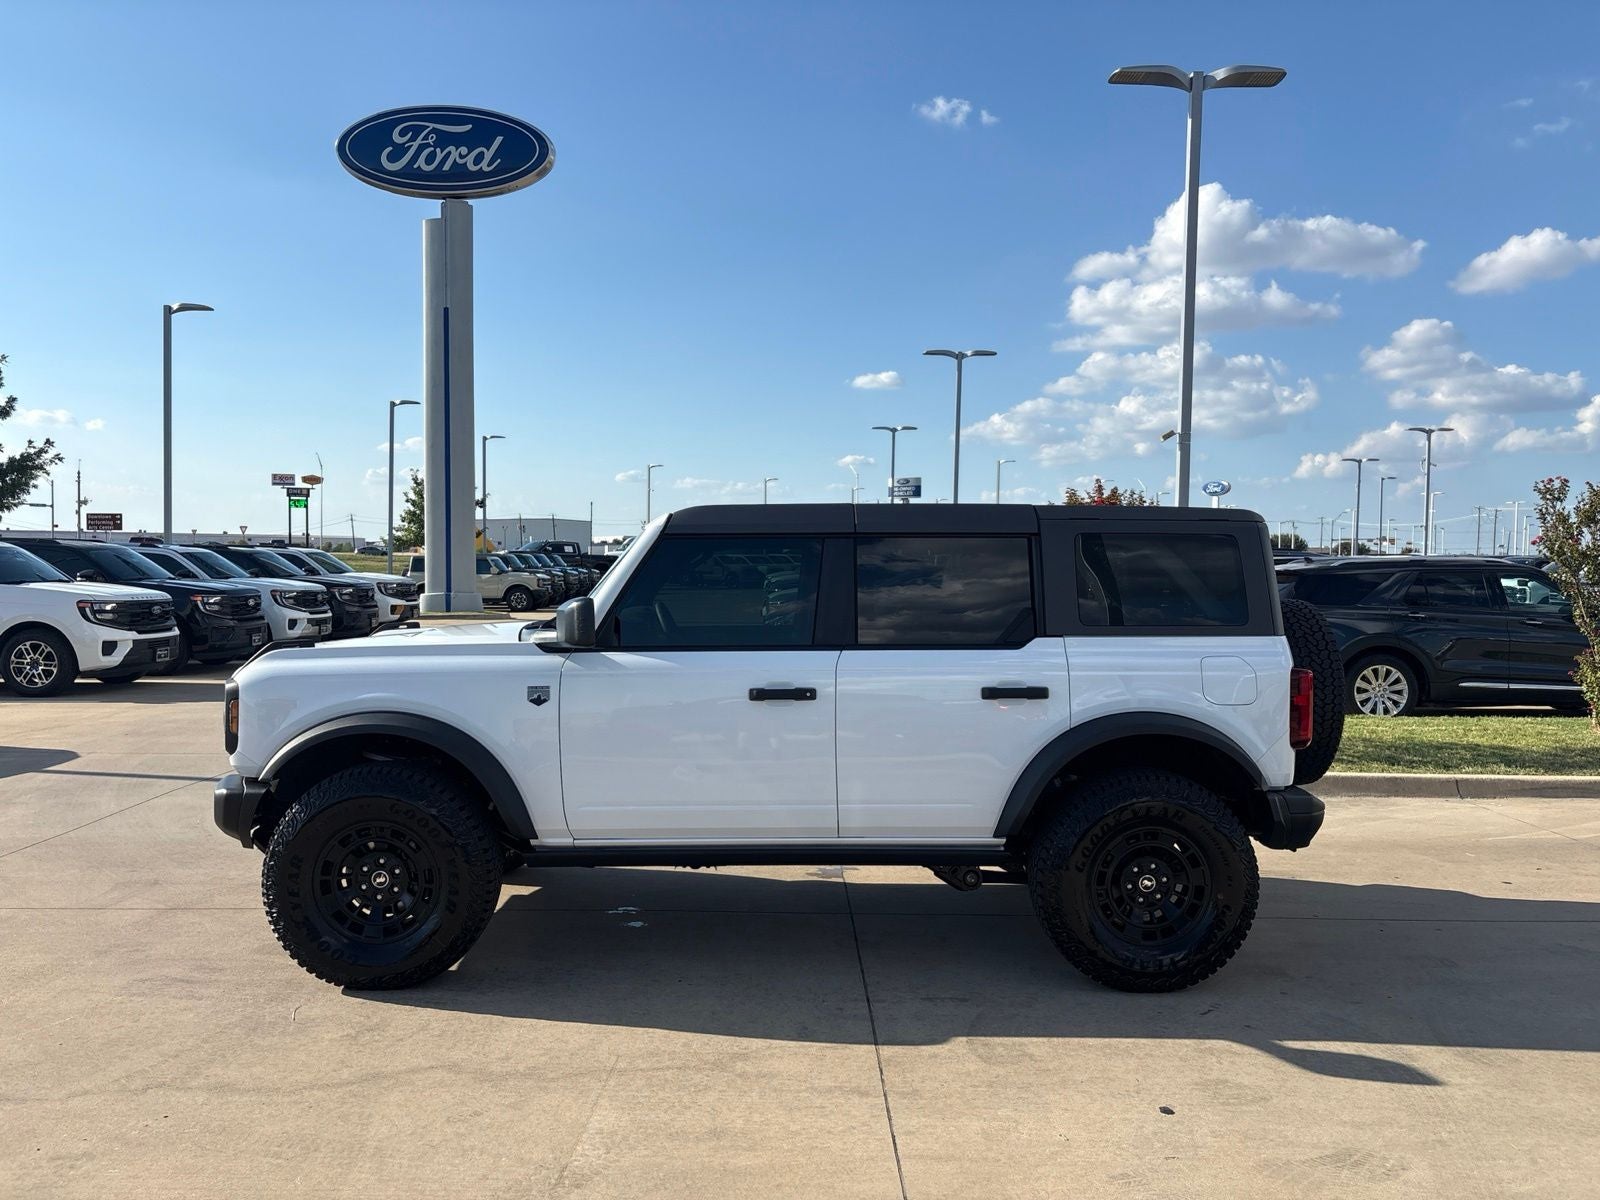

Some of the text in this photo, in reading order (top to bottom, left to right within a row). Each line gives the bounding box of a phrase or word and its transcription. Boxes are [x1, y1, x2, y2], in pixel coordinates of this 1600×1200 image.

[380, 121, 504, 172] Ford
[273, 474, 294, 482] Exxon
[1206, 482, 1223, 493] Ford
